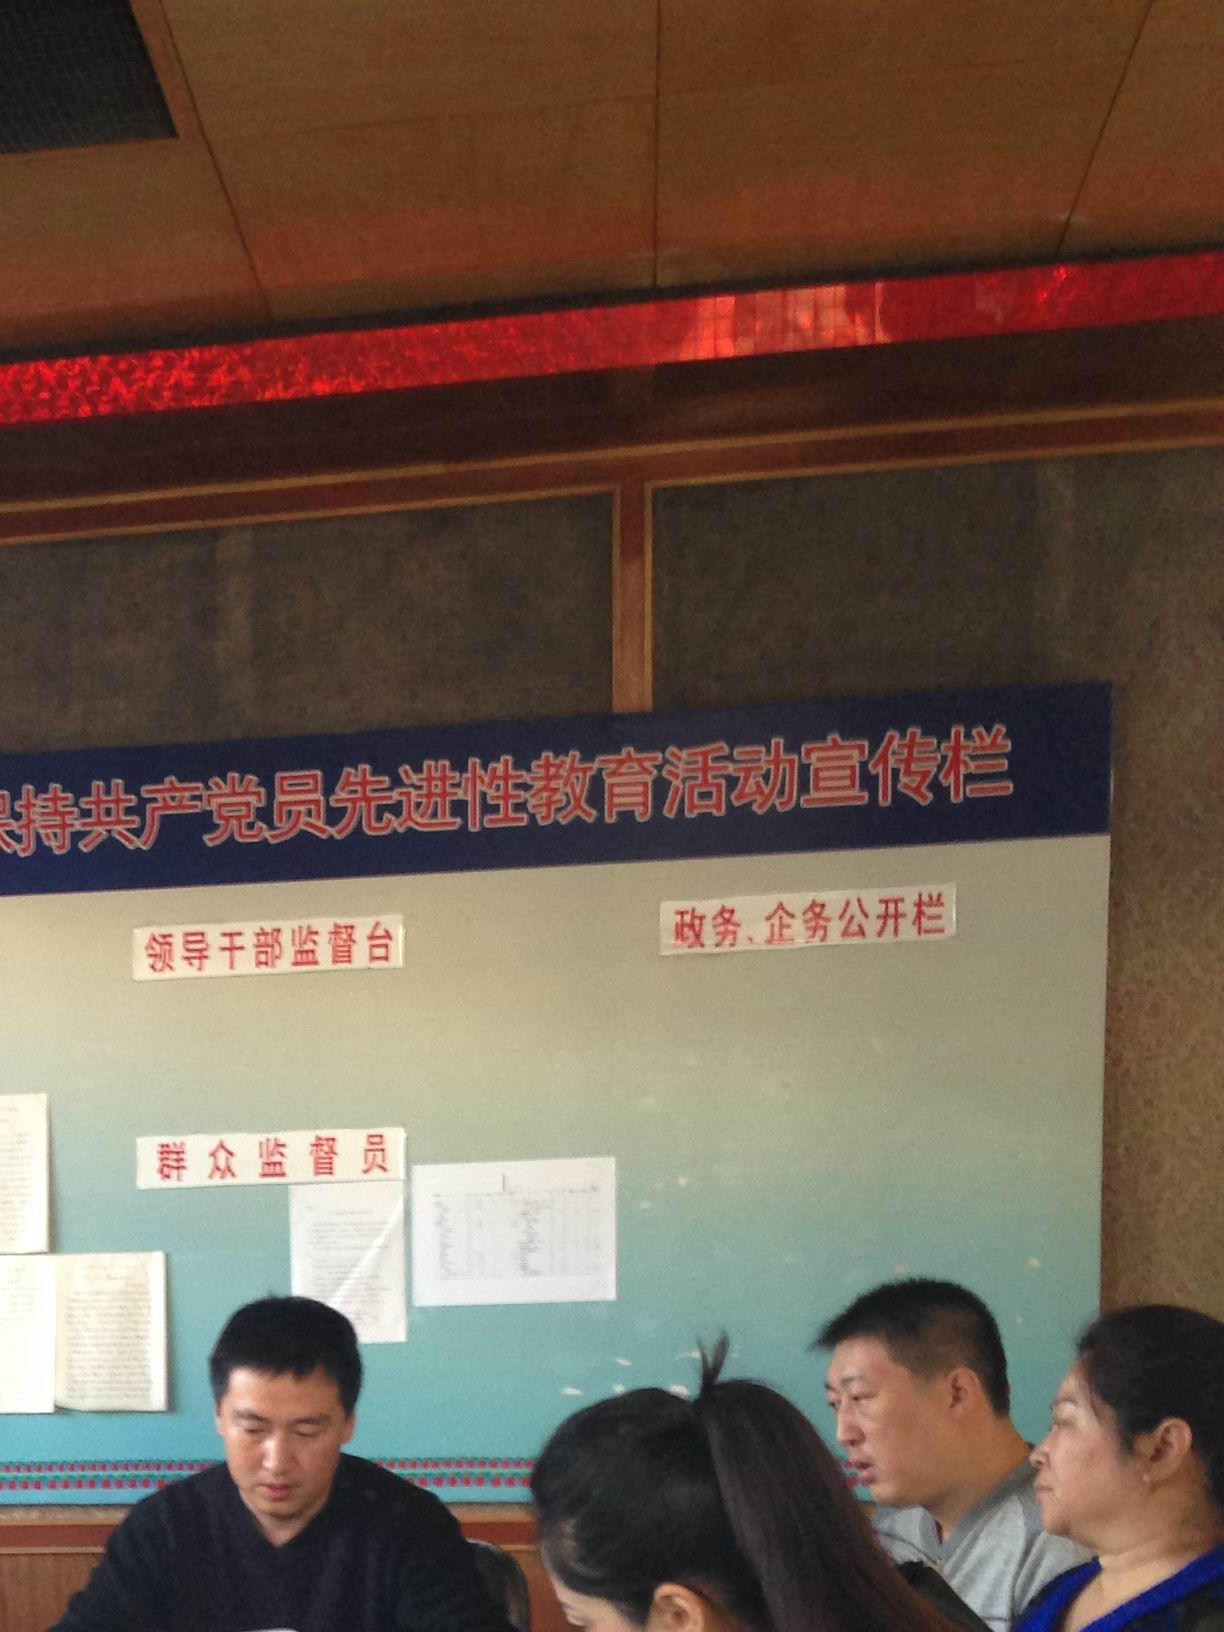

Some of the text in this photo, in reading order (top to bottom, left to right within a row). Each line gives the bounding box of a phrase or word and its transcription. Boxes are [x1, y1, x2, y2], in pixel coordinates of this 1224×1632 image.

[144, 921, 393, 973] 领导干部监督台
[156, 1133, 389, 1182] 群众监督员
